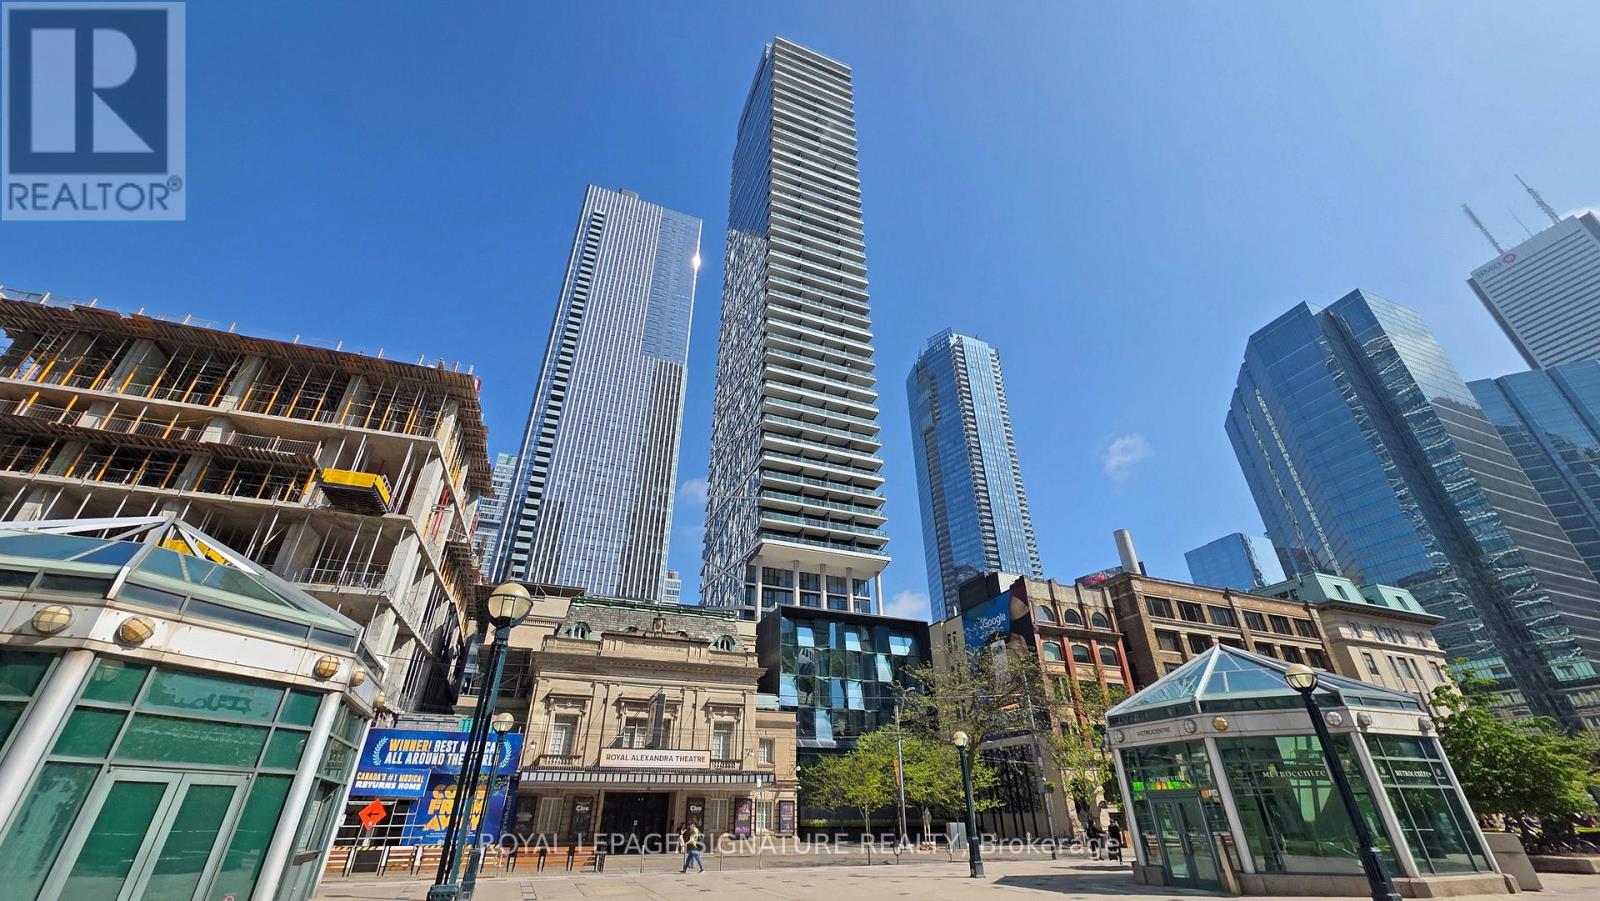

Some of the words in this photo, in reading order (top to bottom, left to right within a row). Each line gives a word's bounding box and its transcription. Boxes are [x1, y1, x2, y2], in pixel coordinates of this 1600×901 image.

[982, 612, 1006, 629] Google
[389, 739, 432, 752] WINNER!
[433, 740, 458, 752] BEST
[384, 751, 403, 765] ALL
[404, 752, 446, 765] AROUND
[447, 753, 466, 766] THE
[356, 772, 387, 782] CANADA'S
[387, 774, 398, 782] #1
[398, 774, 424, 783] MUSICAL
[355, 780, 396, 790] RETURNS
[397, 783, 422, 791] HOME
